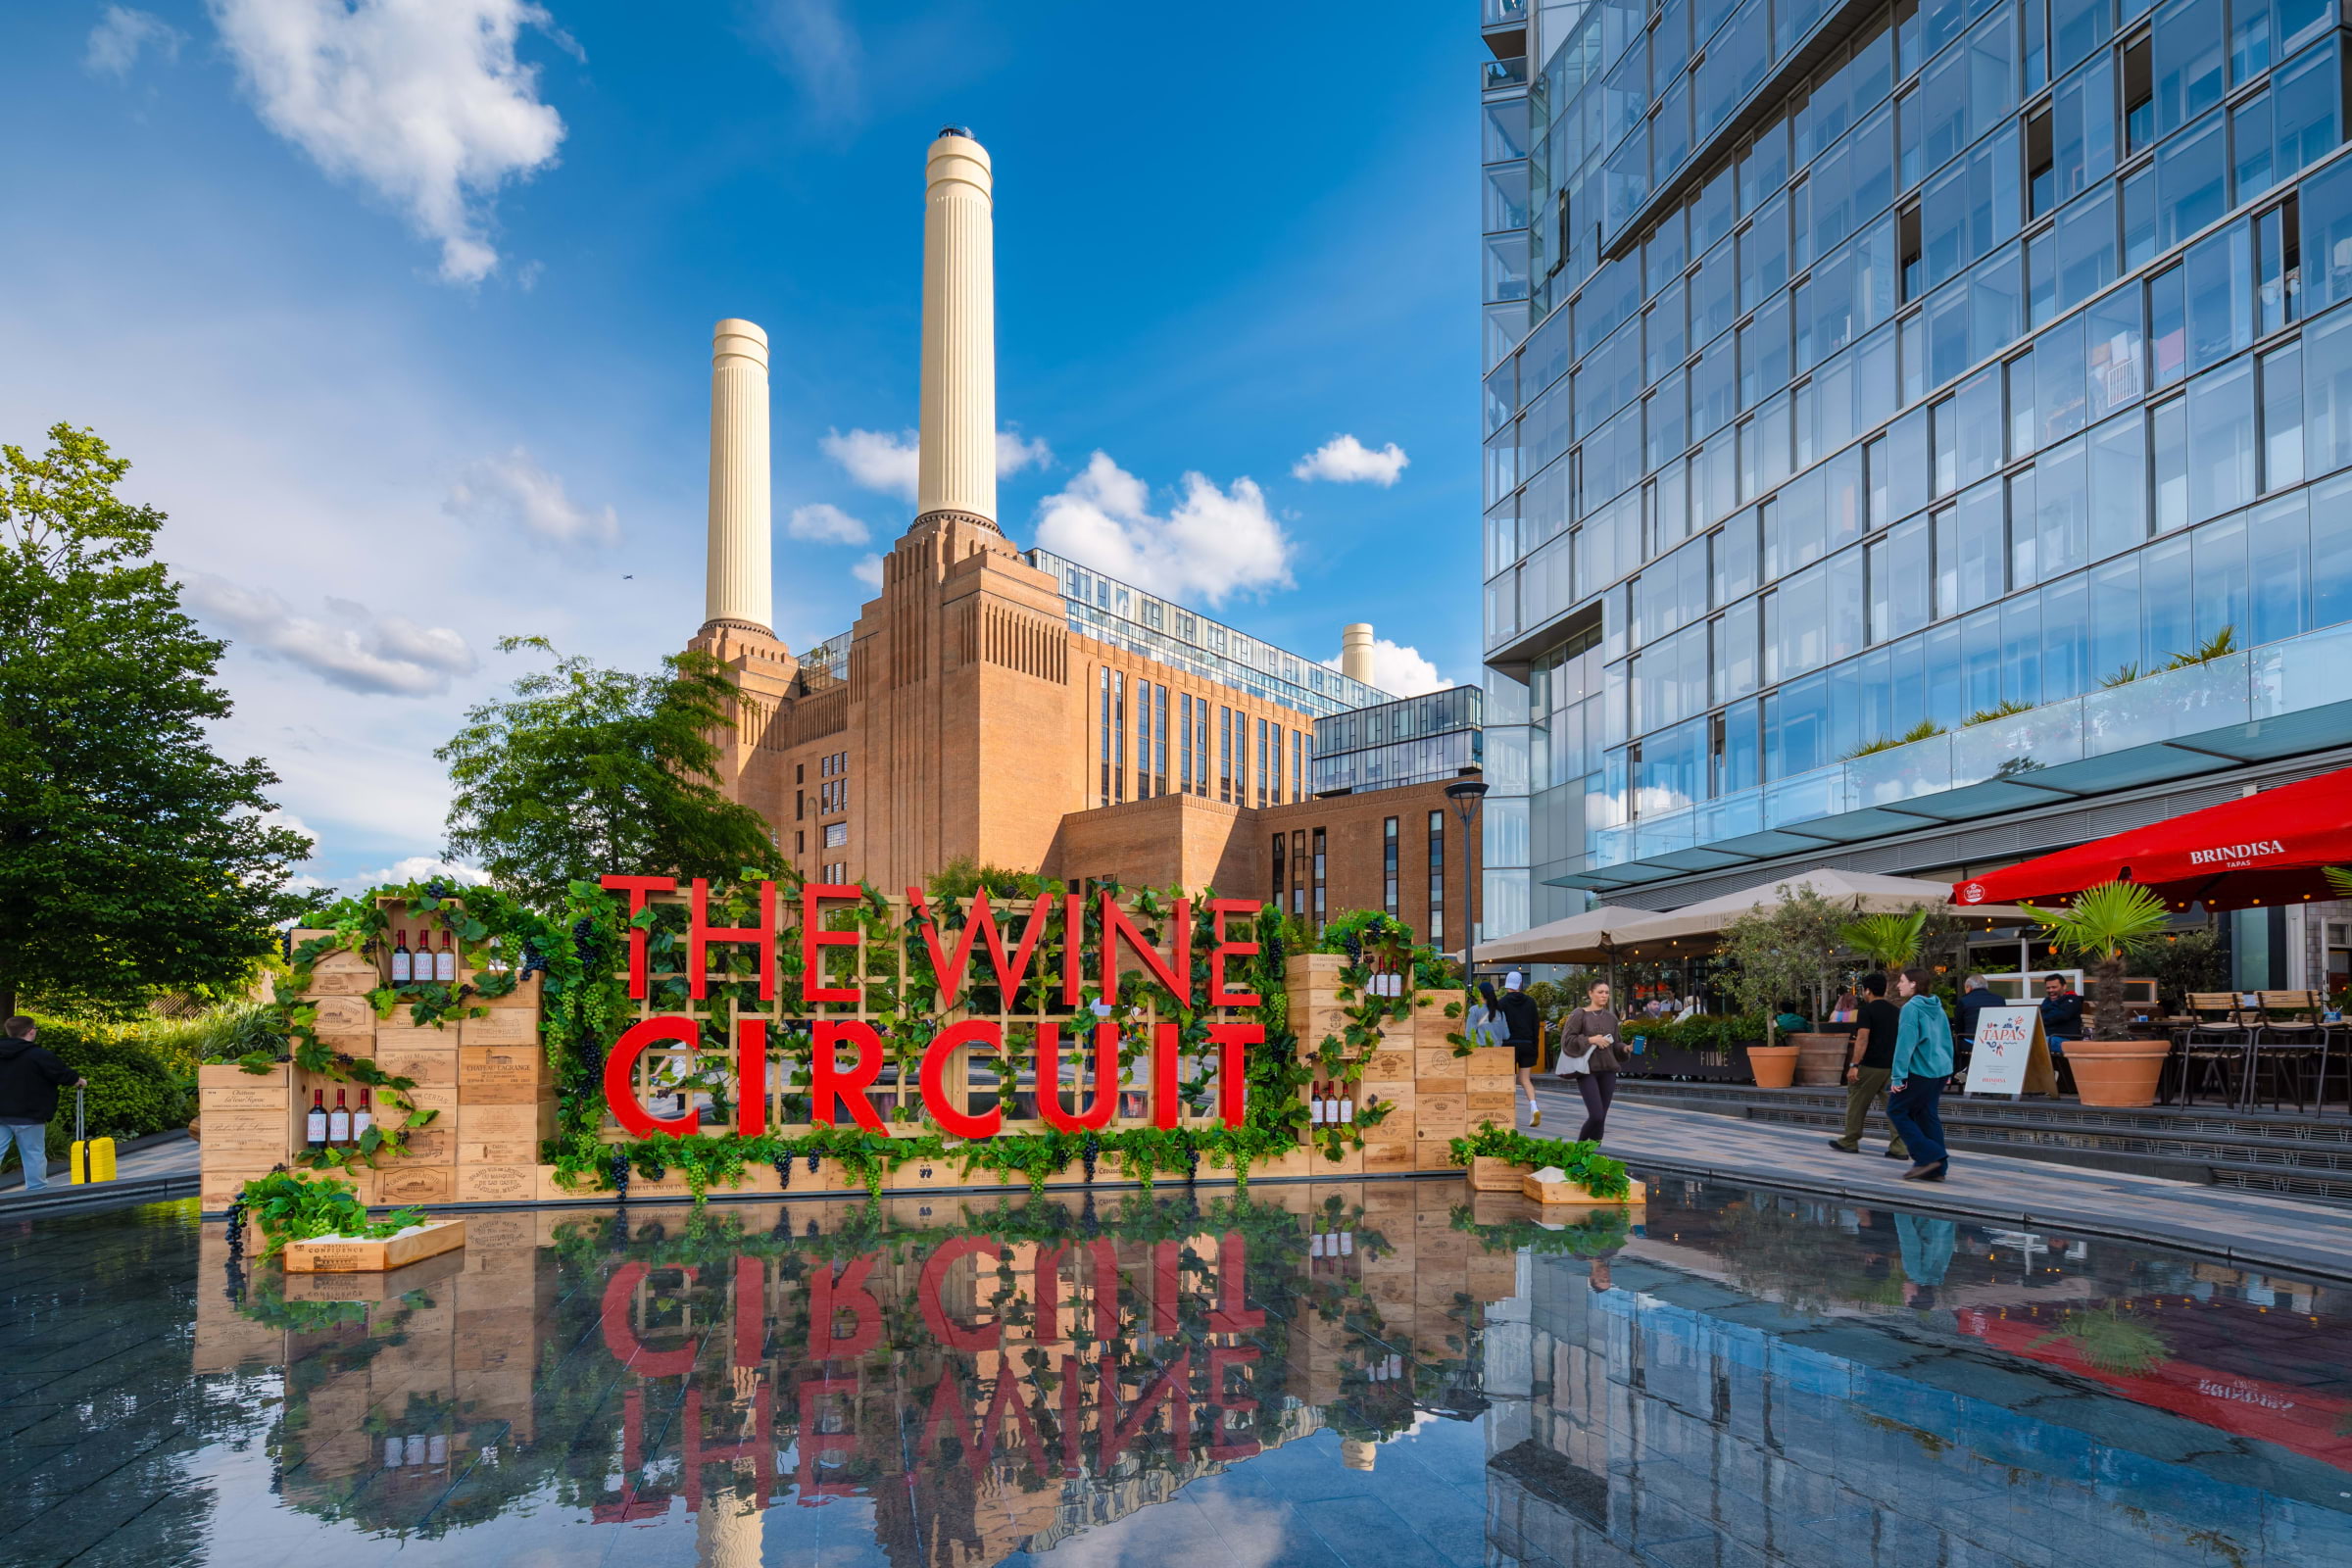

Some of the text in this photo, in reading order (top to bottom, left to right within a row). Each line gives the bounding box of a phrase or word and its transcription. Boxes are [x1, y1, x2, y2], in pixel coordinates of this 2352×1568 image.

[2189, 840, 2285, 864] BRINDISA
[2226, 859, 2251, 868] TAPAS
[601, 874, 1261, 1010] THE WINE
[1983, 1029, 2027, 1041] TAPAS
[1700, 1051, 1729, 1067] FIUME
[604, 1016, 1266, 1140] CIRCUIT
